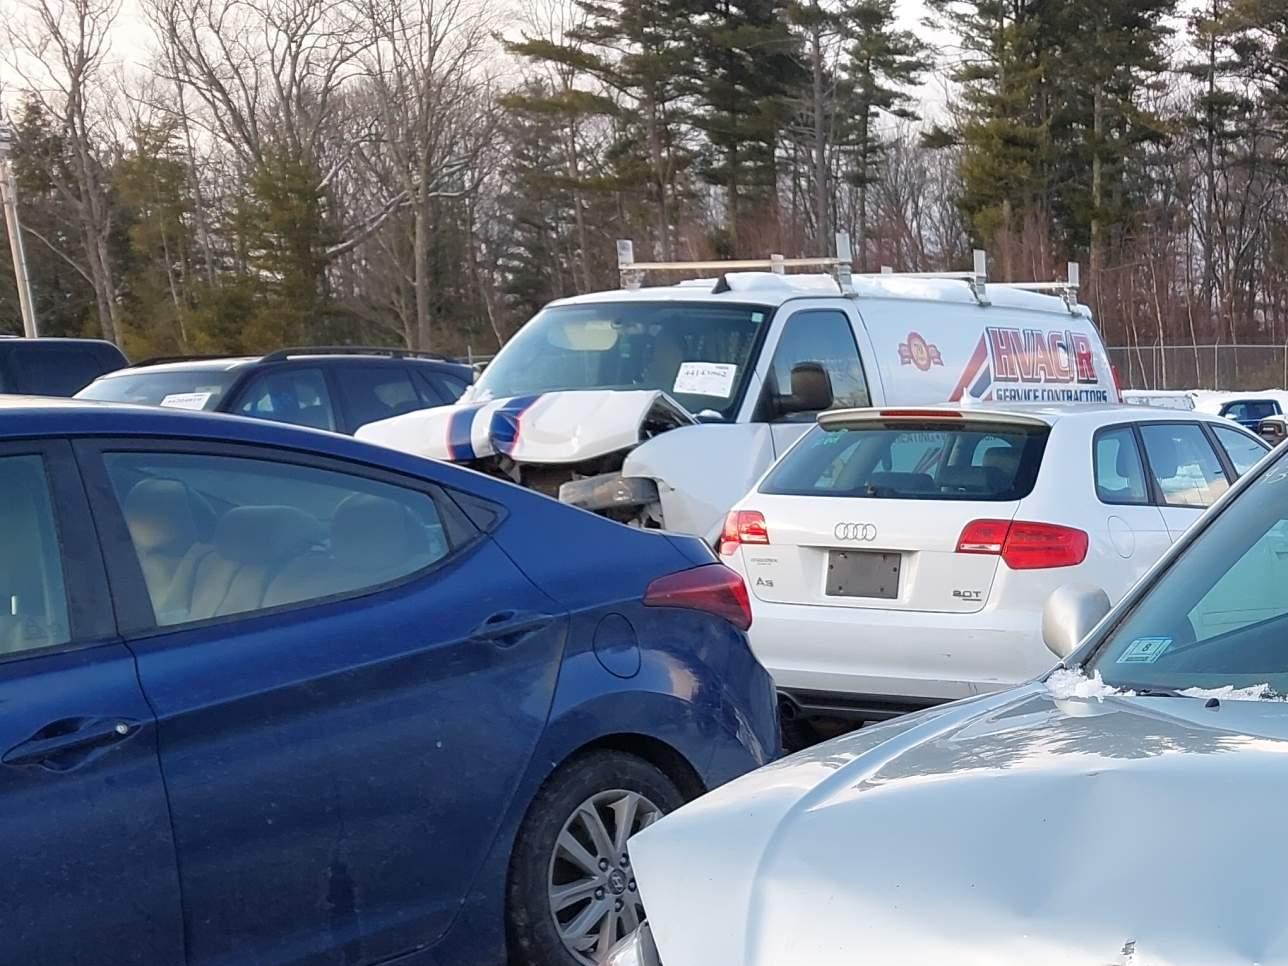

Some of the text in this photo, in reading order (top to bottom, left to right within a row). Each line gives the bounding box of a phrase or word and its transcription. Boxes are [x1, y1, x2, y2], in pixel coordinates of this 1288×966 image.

[996, 388, 1108, 402] SERVICE CONTRACTORS
[756, 577, 773, 587] A3
